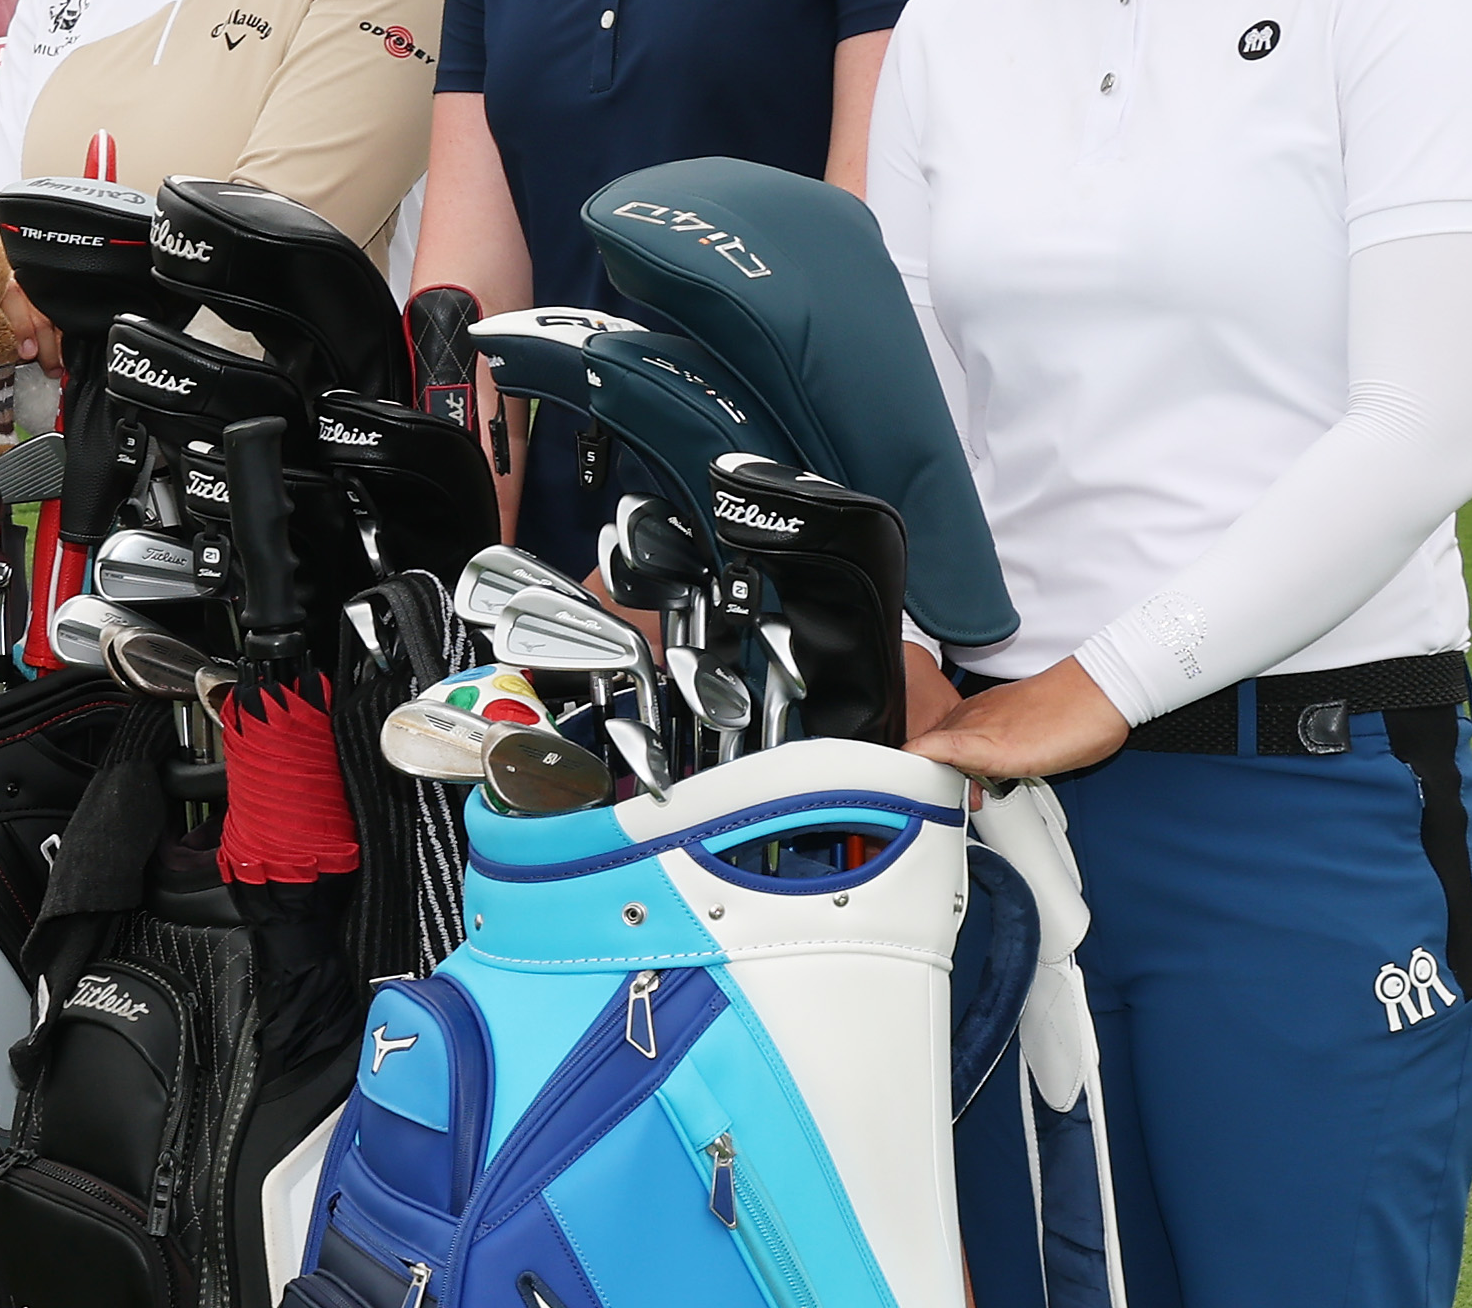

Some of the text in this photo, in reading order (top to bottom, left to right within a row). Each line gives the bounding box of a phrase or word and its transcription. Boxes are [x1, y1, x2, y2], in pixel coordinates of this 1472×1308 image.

[359, 22, 436, 65] ODYSSEY
[20, 225, 104, 247] TRI-FORCE
[108, 343, 197, 394] Titleist
[319, 416, 383, 446] Titleist
[186, 471, 230, 503] Titl
[714, 490, 805, 533] Titleist
[142, 547, 188, 567] Titleist
[63, 975, 150, 1022] Titleist
